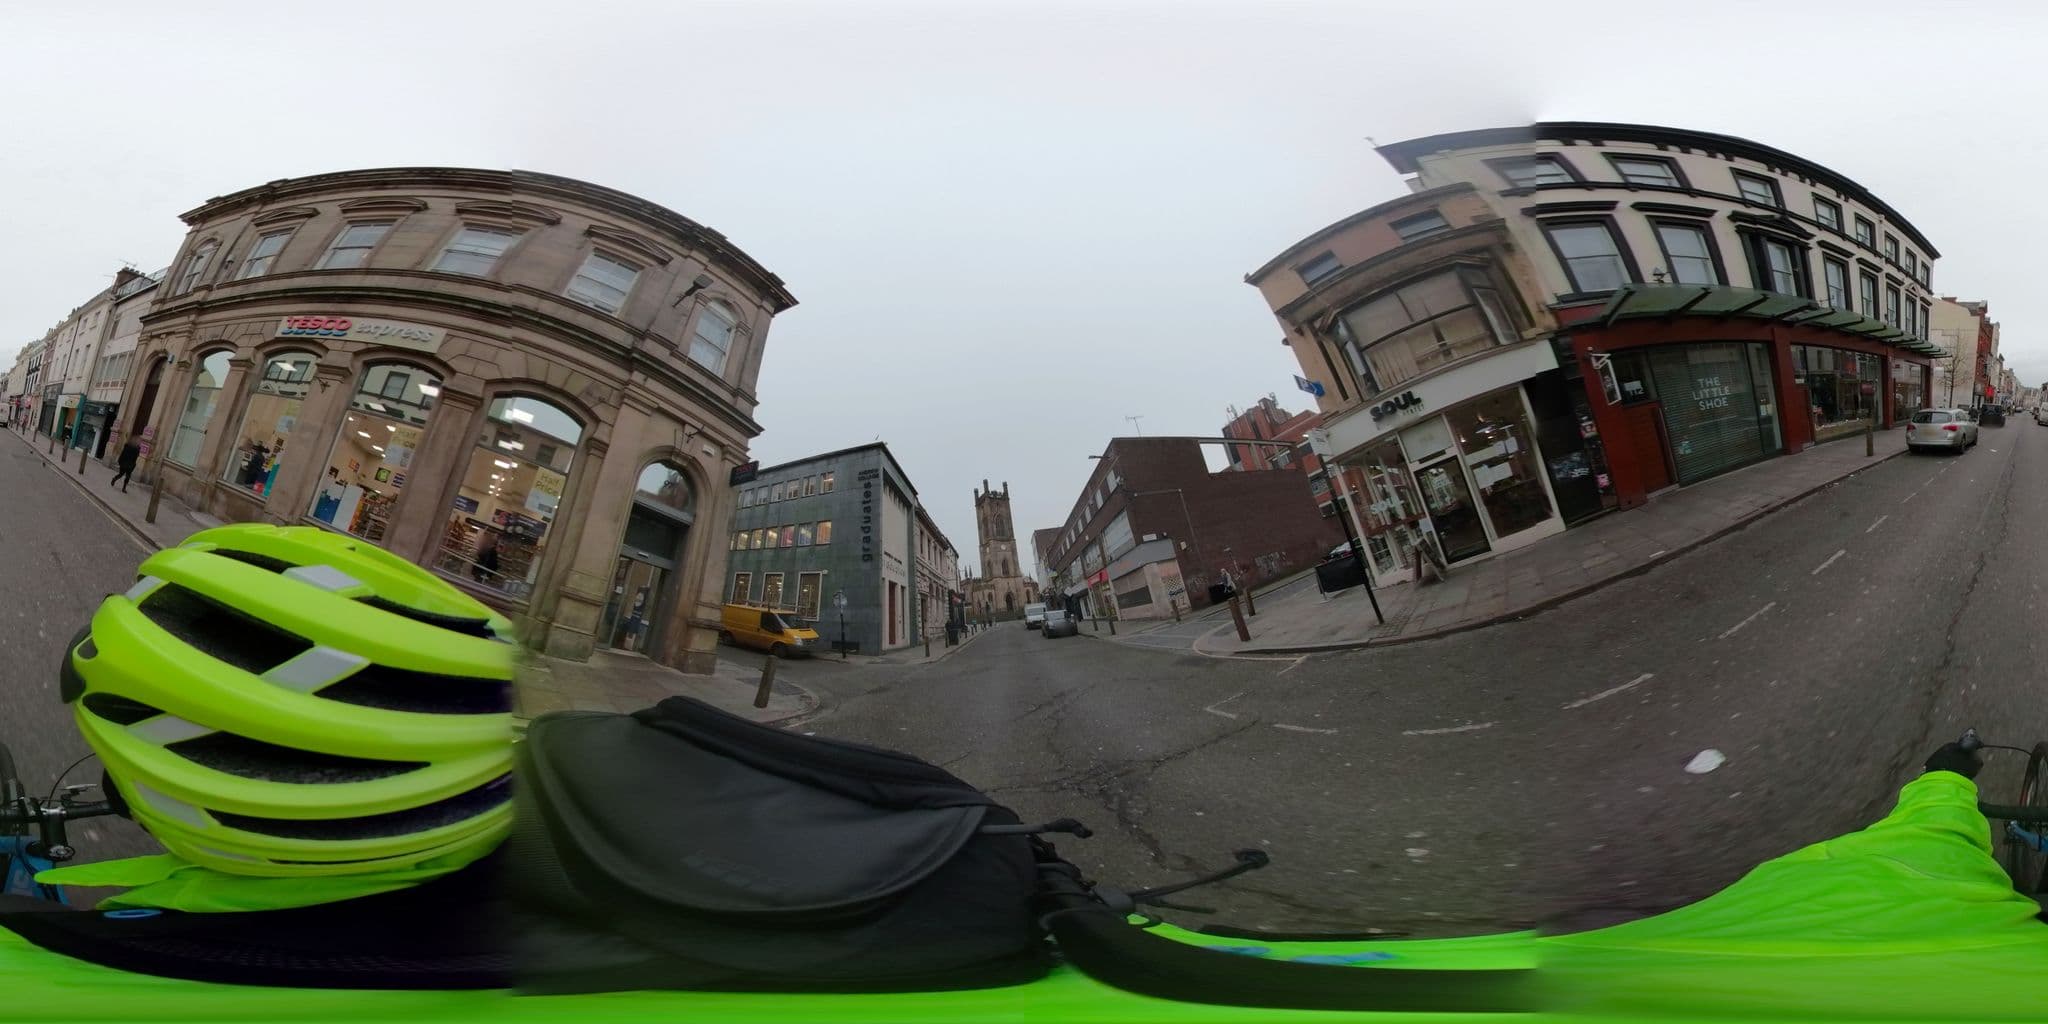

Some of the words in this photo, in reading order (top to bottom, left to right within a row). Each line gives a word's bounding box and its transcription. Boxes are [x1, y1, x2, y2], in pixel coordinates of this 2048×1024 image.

[287, 318, 352, 331] TESCO
[356, 320, 433, 342] express
[1697, 376, 1721, 388] THE
[1692, 386, 1732, 400] LITTLE
[1370, 391, 1422, 423] SOUL
[1699, 397, 1729, 411] SHOE
[861, 481, 873, 562] graduates
